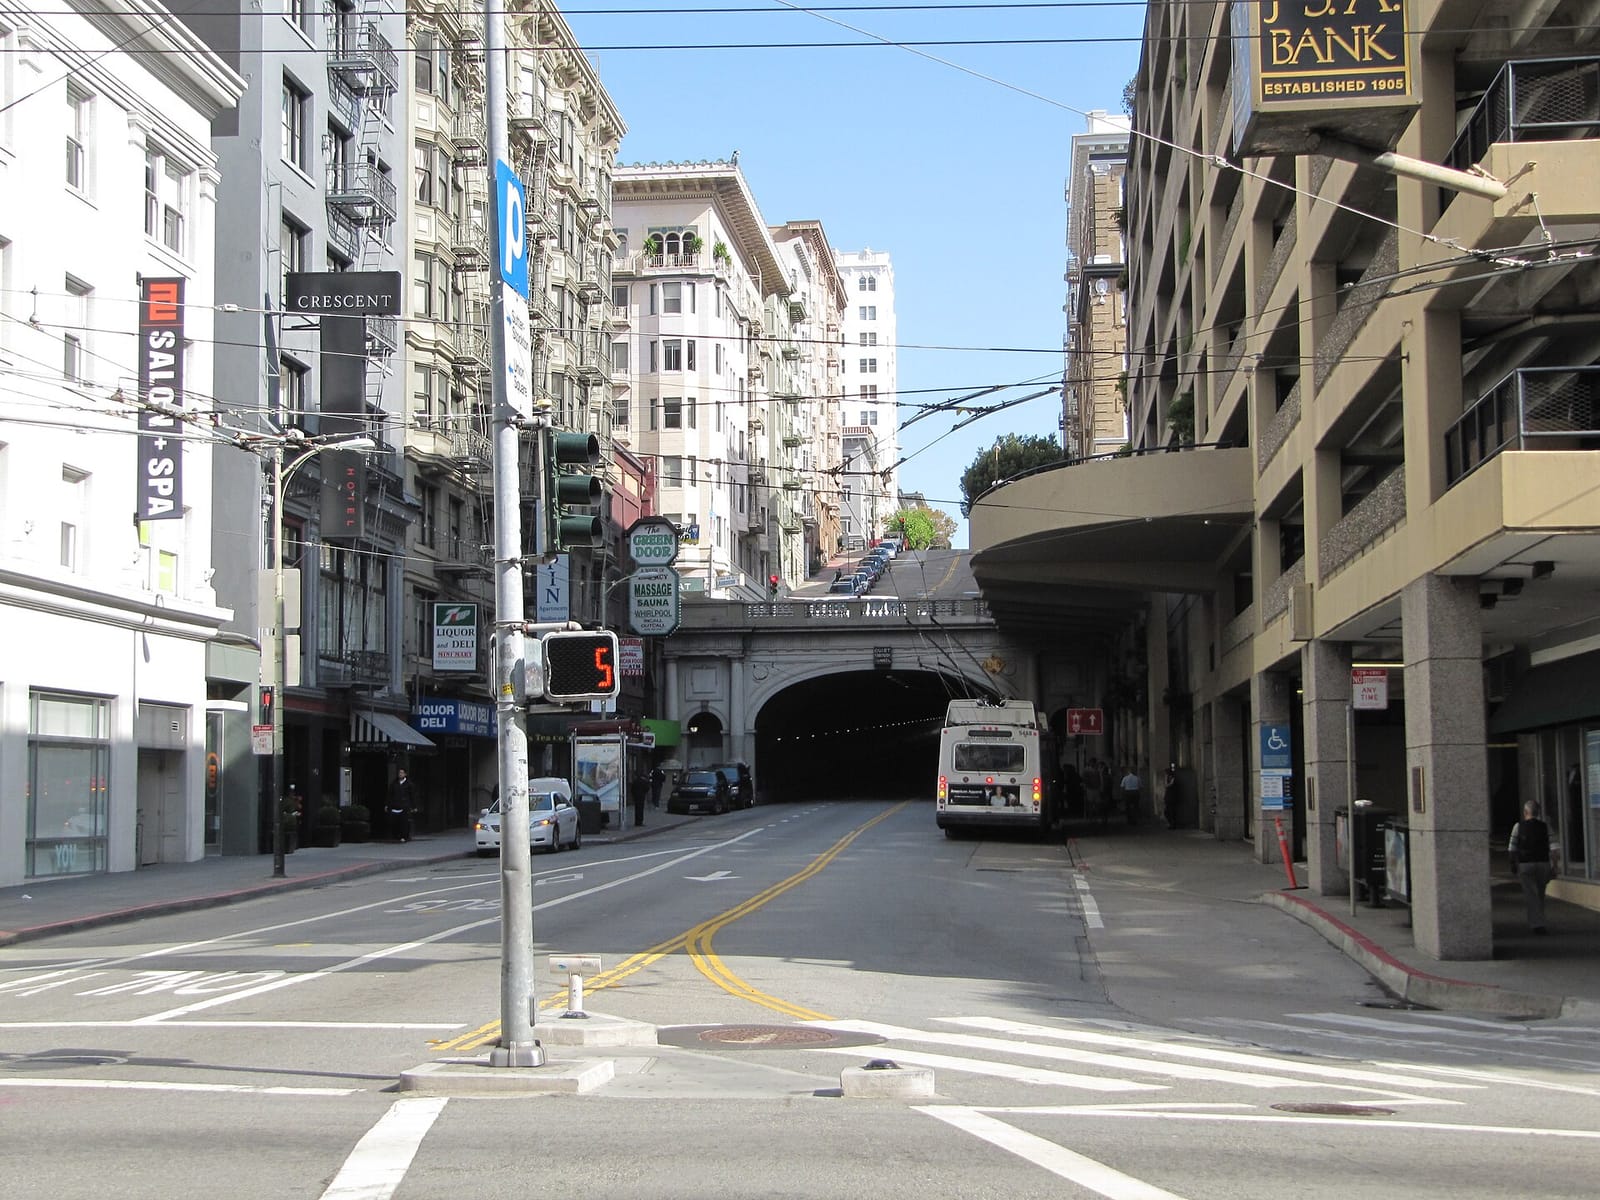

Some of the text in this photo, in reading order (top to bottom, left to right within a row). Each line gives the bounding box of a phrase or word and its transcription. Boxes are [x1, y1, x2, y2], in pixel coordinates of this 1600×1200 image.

[1269, 23, 1398, 65] BANK
[1264, 79, 1404, 95] ESTABLISHED 1905
[298, 294, 392, 308] CRESCENT
[148, 330, 176, 427] SALON
[147, 457, 175, 516] SPA
[346, 467, 356, 527] HOTEL
[644, 525, 660, 534] The
[633, 534, 673, 546] GREEN
[635, 546, 672, 558] DOOR
[634, 583, 672, 596] MASSAGE
[637, 598, 669, 607] SAUNA
[635, 610, 672, 618] WHIRLPOOL
[436, 628, 475, 638] LIQUOR
[452, 640, 474, 649] DELI
[594, 647, 612, 687] 5
[1352, 676, 1363, 684] NO
[411, 704, 455, 716] LIQUOR
[420, 717, 447, 728] DELI
[55, 844, 77, 866] YOU
